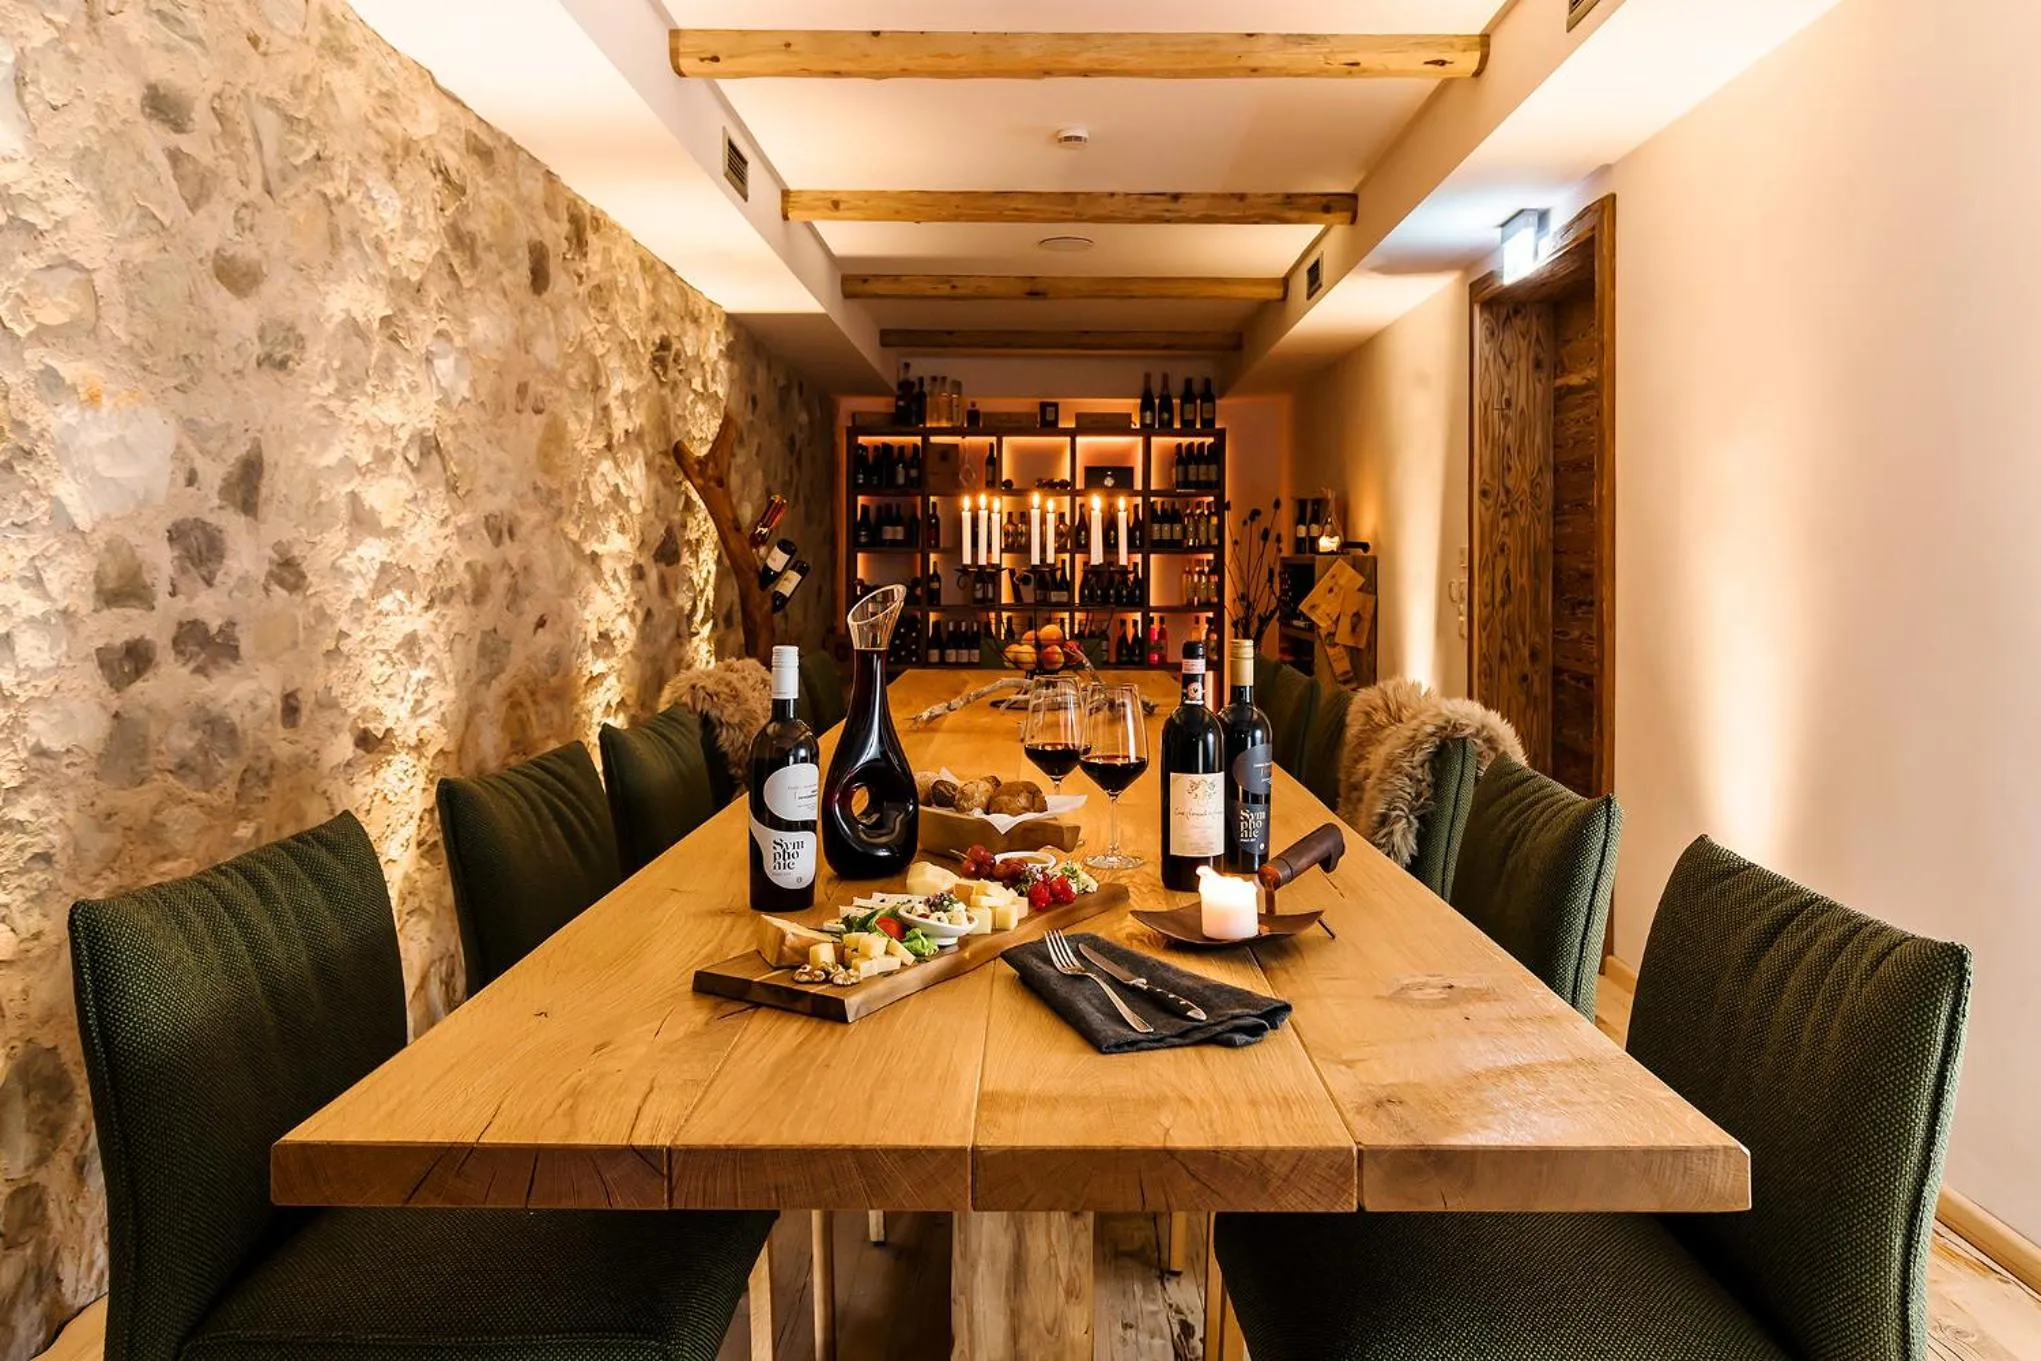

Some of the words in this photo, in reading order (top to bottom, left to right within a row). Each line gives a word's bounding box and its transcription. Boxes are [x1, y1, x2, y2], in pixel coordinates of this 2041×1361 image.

[1240, 810, 1266, 820] Sym
[1240, 819, 1262, 831] pho
[773, 838, 804, 850] Sym
[773, 849, 800, 863] pho
